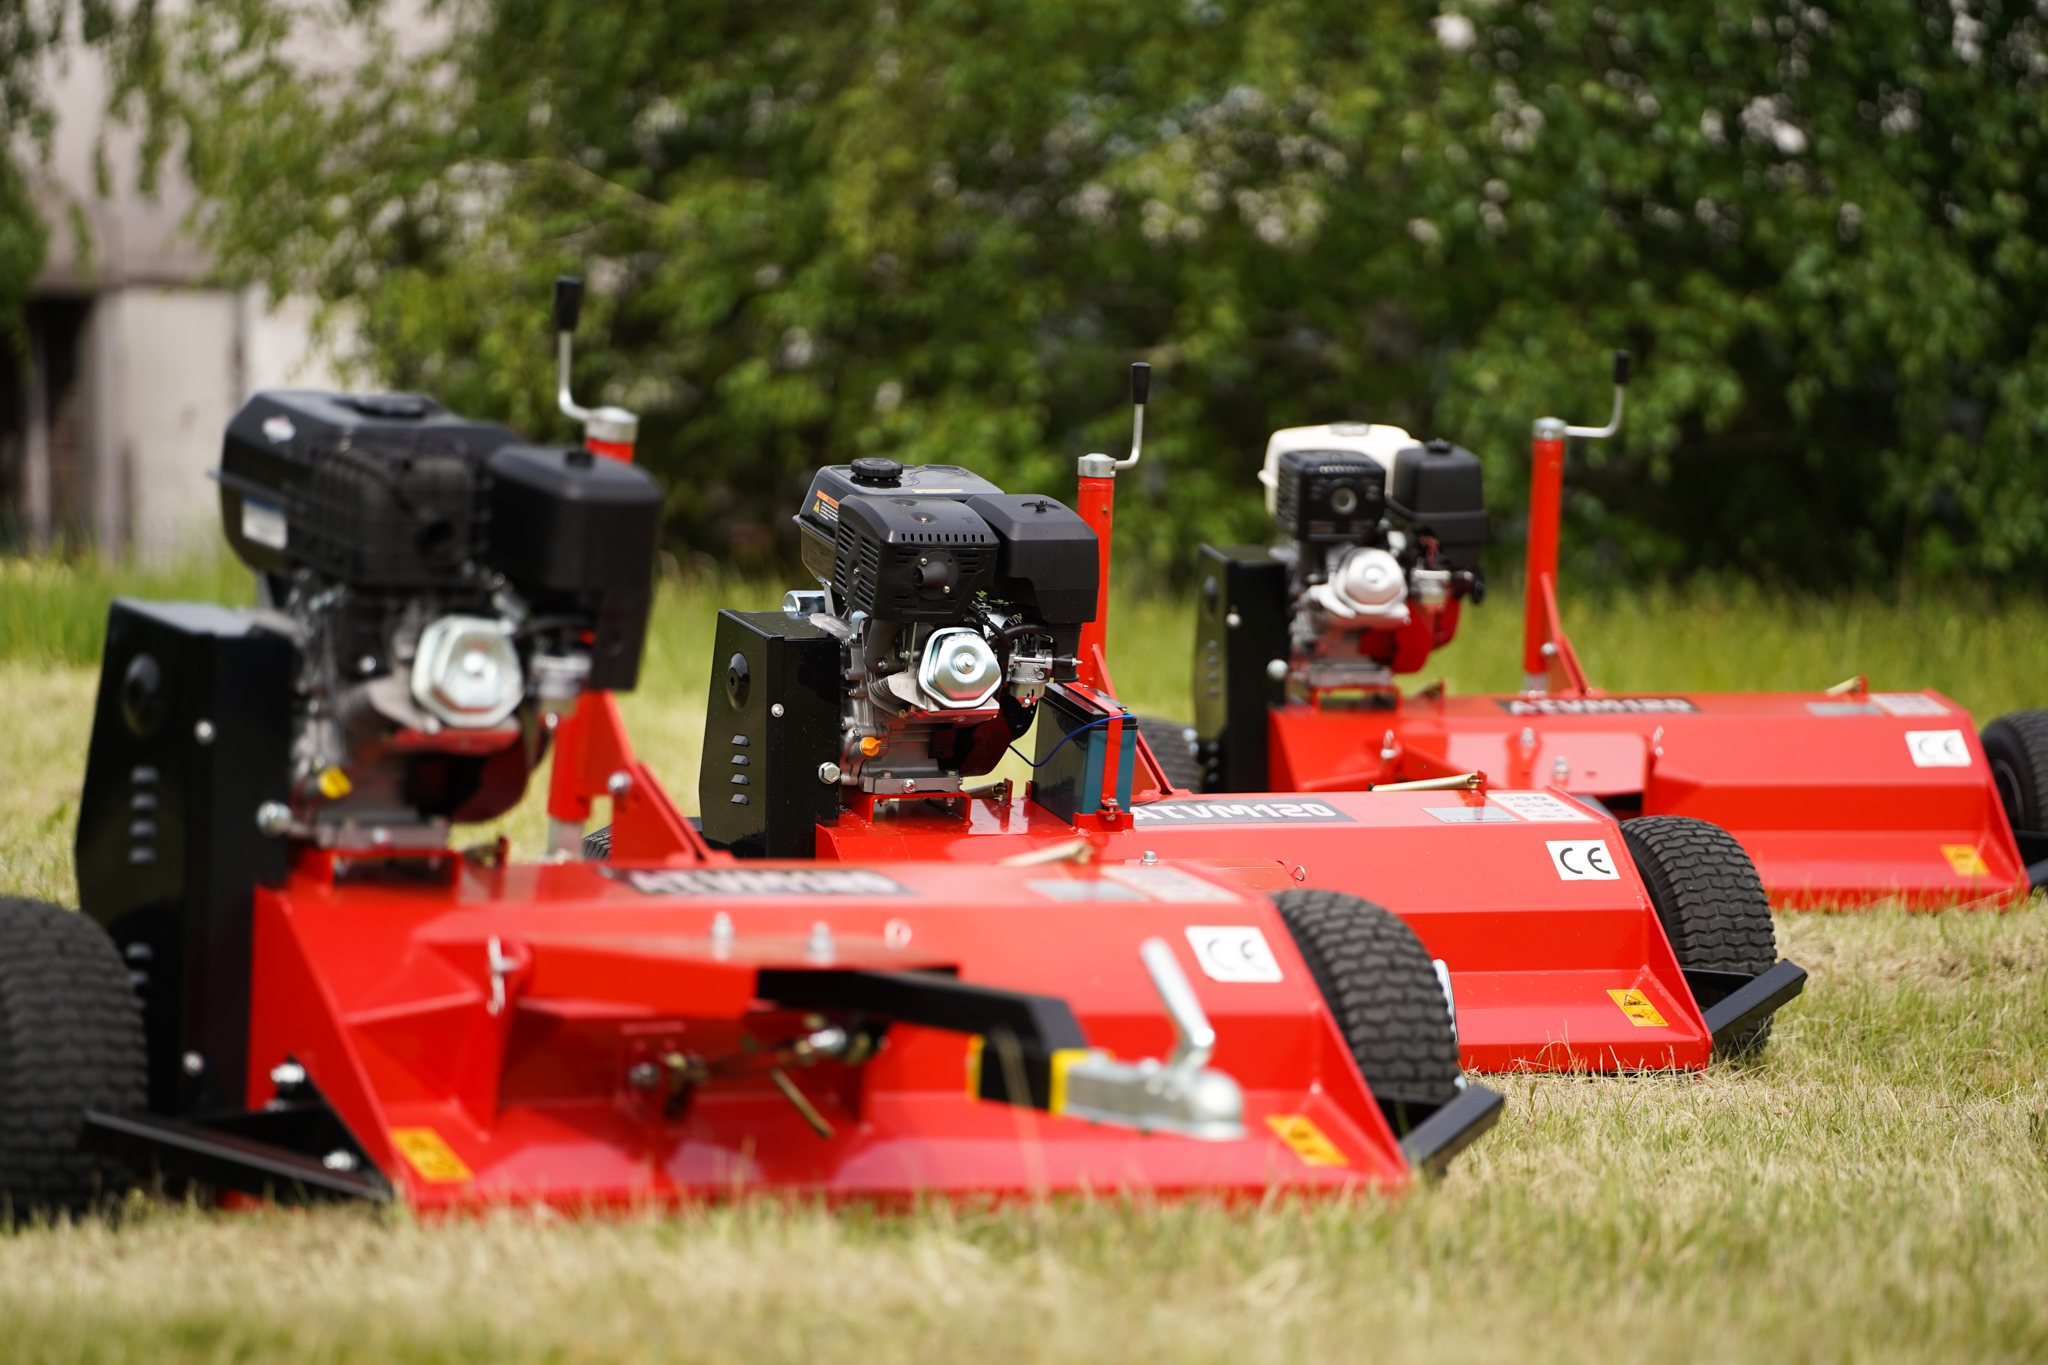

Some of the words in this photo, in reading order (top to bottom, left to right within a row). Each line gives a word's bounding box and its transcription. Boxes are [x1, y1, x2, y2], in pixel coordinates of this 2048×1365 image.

[1918, 737, 1962, 758] CE
[1131, 803, 1337, 820] ATVM120
[1559, 847, 1611, 874] CE
[1207, 938, 1268, 972] CE
